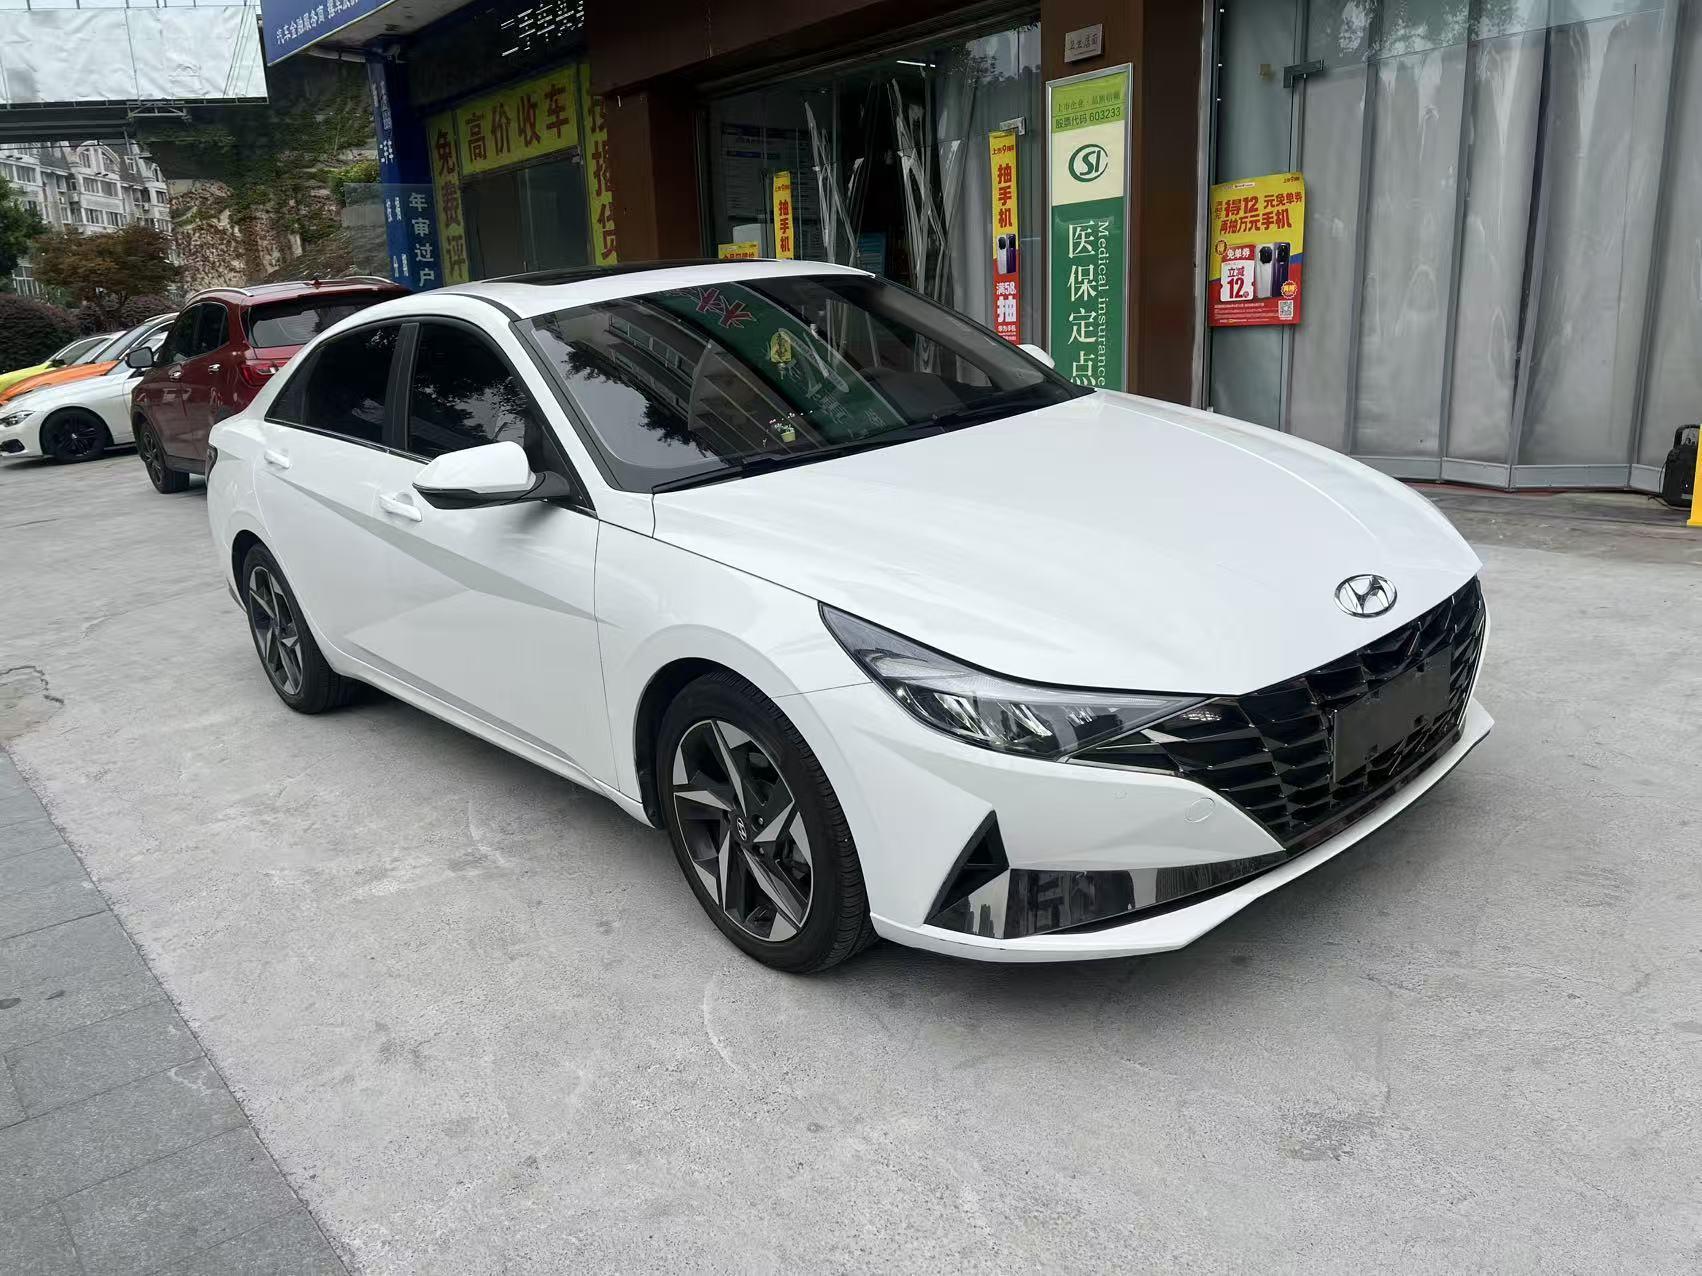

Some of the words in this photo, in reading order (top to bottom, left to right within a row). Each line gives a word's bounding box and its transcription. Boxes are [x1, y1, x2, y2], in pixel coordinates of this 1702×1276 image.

[465, 83, 569, 161] 高价收车
[1055, 113, 1087, 129] 股票代码
[1089, 106, 1121, 122] 603233
[436, 128, 466, 279] 免费评
[779, 199, 790, 253] 抽手机
[997, 162, 1013, 229] 抽手机
[1220, 208, 1292, 235] 再抽万元手机
[408, 193, 435, 287] 年审过户
[1098, 220, 1110, 290] Medical
[1227, 247, 1251, 260] 免单券
[1228, 265, 1245, 278] 立减
[997, 295, 1017, 323] 抽
[1067, 220, 1097, 386] 医保定点
[1097, 298, 1109, 387] insurance
